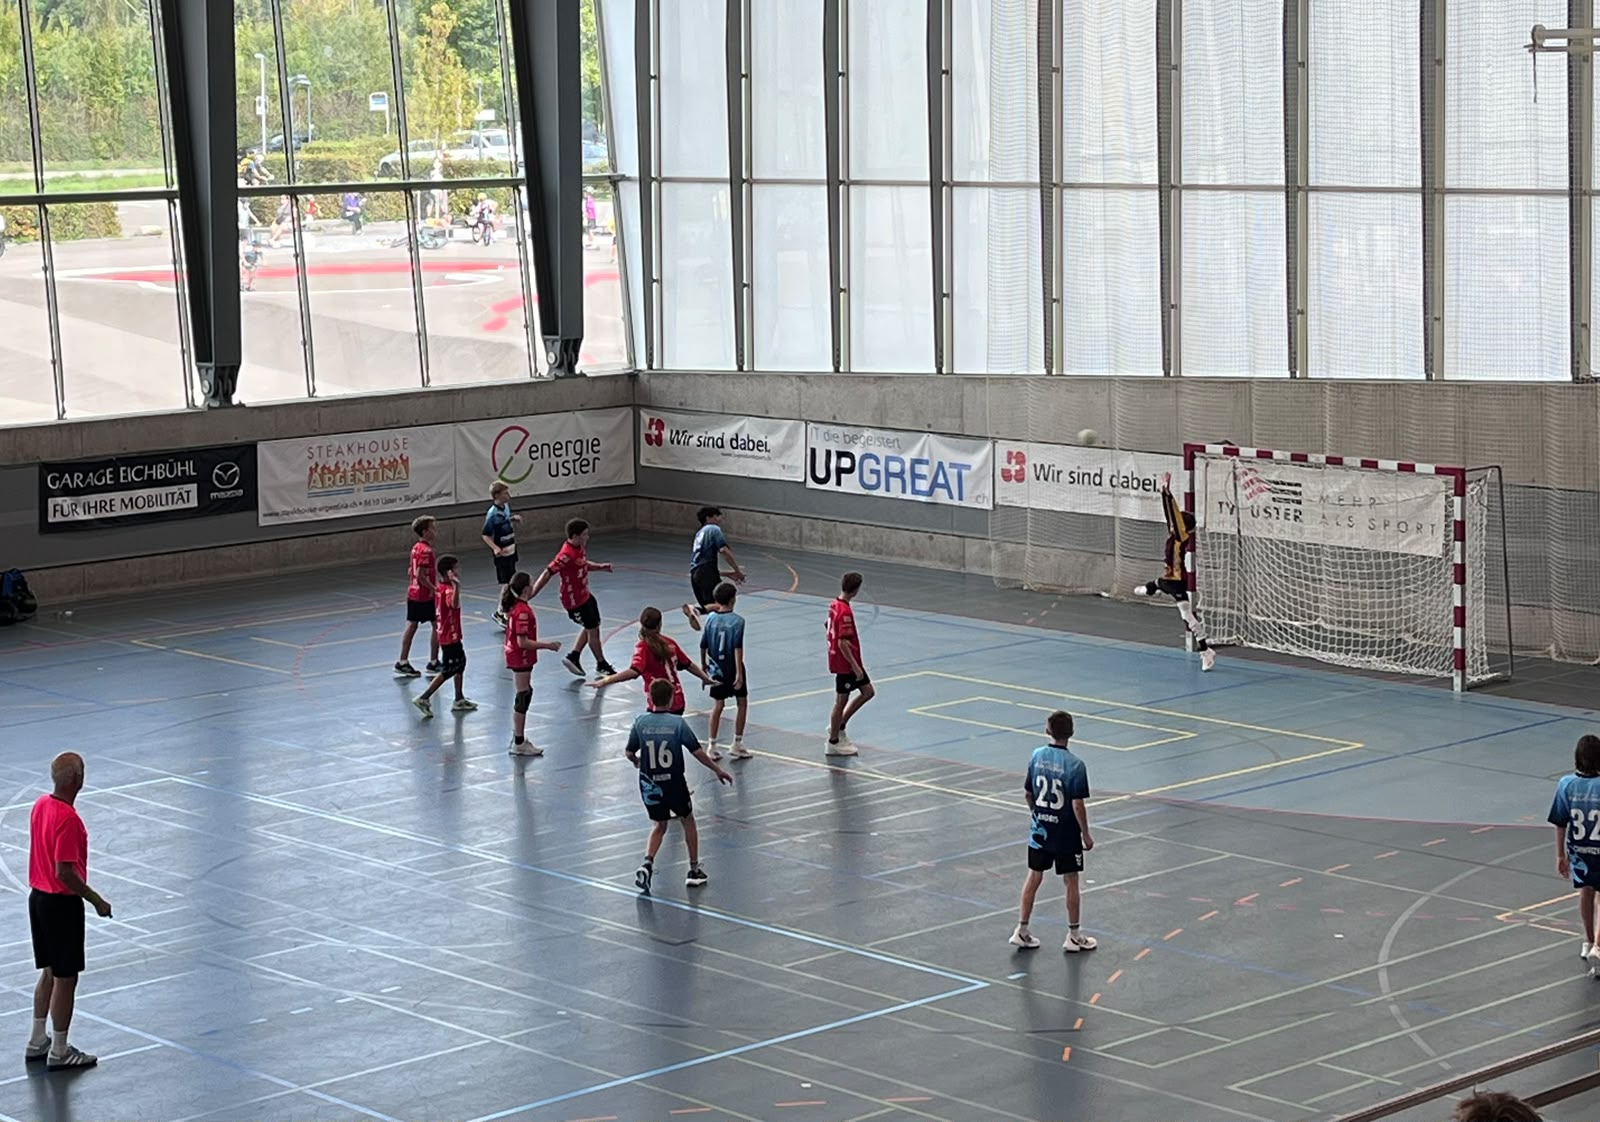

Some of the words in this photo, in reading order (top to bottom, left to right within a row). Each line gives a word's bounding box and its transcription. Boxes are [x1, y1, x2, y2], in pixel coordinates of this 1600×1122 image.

[669, 429, 694, 446] Wir
[696, 430, 725, 449] sind
[729, 433, 771, 453] dabei.
[810, 426, 821, 441] IT
[823, 430, 840, 444] die
[307, 437, 409, 460] STEAKHOUSE
[528, 437, 601, 462] energie
[47, 467, 115, 490] GARAGE
[119, 459, 198, 483] EICHBÜHL
[309, 465, 409, 490] ARGENTINA
[548, 457, 601, 478] uster
[809, 447, 972, 501] UPGREAT
[1033, 463, 1063, 483] Wir
[1068, 466, 1103, 487] sind
[1110, 469, 1161, 493] dabei.
[52, 498, 79, 518] FÜR
[83, 498, 116, 516] IHRE
[119, 487, 192, 512] MOBILITÄT
[1250, 504, 1304, 523] USTER
[1368, 517, 1436, 536] SPORT
[645, 740, 673, 769] 16
[1035, 775, 1065, 811] 25
[1570, 808, 1600, 841] 32
